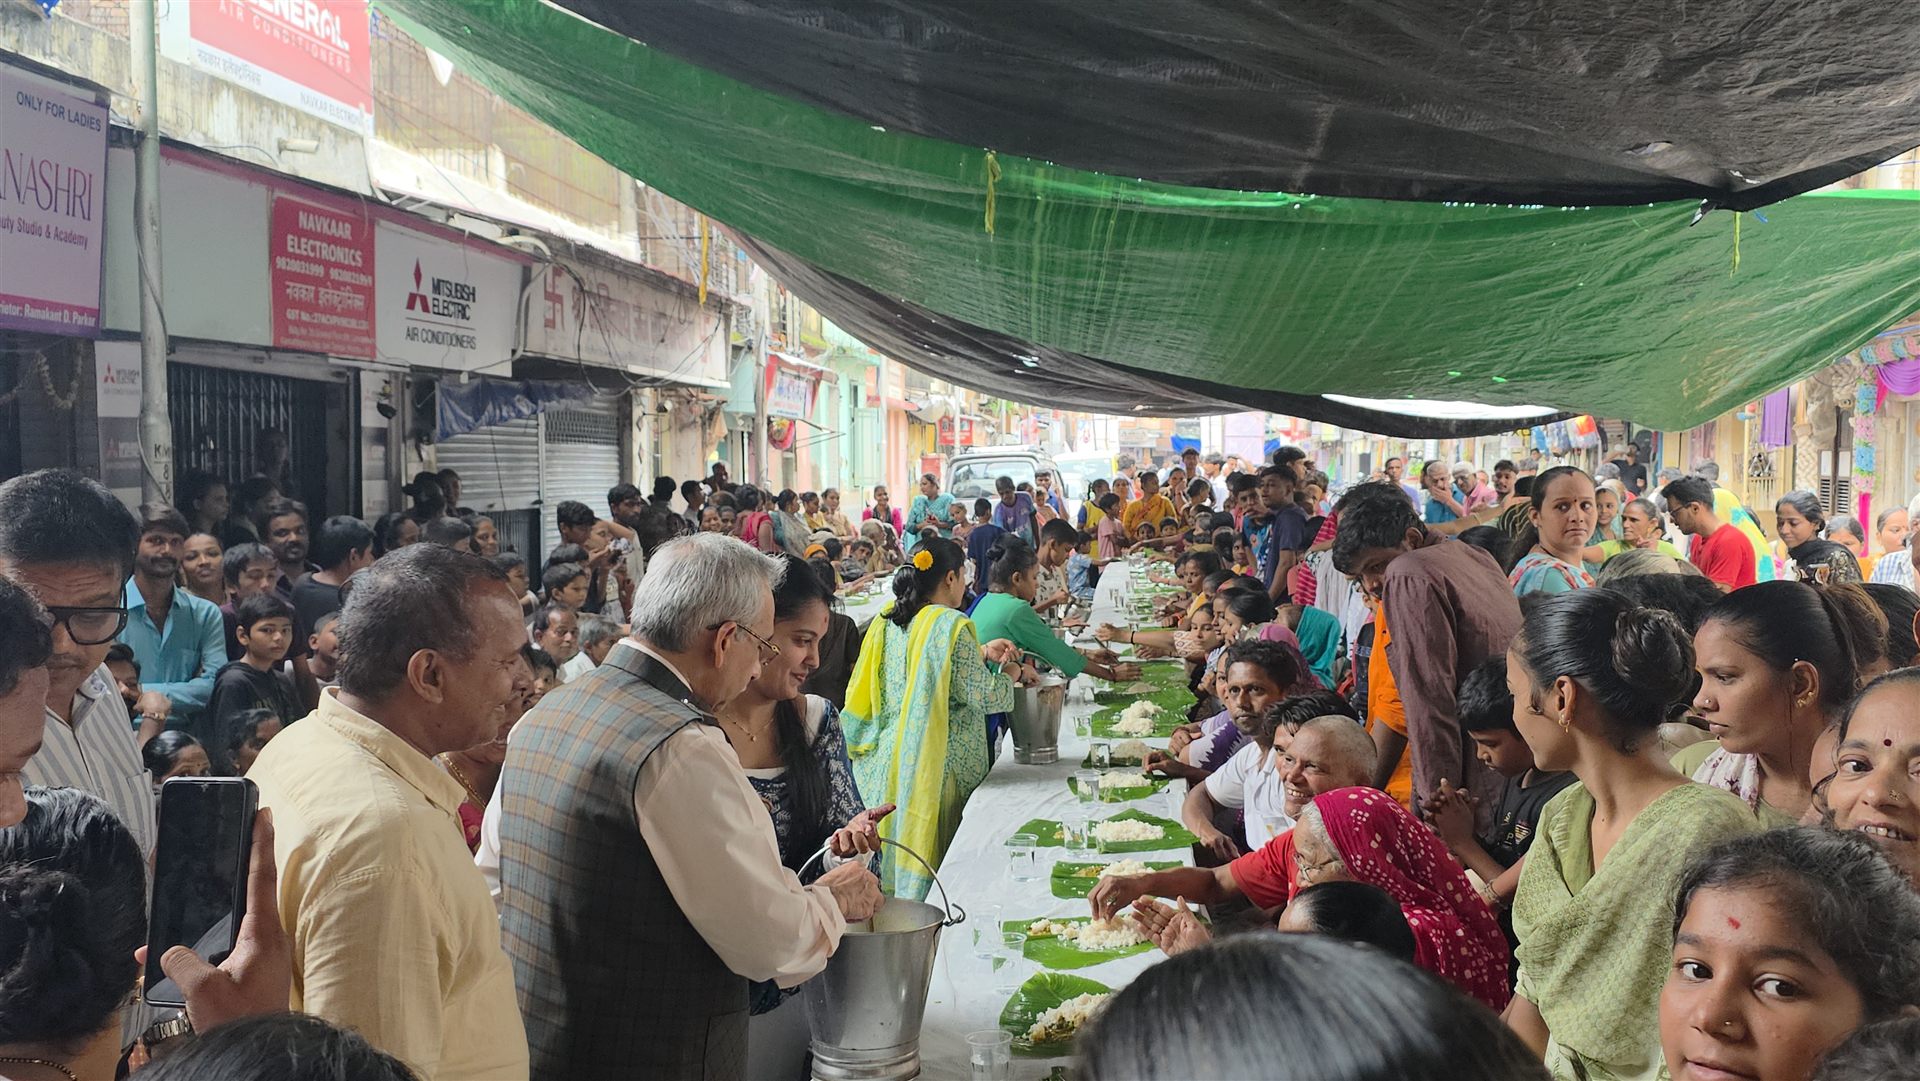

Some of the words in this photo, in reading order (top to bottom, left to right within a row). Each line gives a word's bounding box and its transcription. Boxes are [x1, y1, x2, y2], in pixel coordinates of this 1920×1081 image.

[218, 0, 245, 22] AIR
[253, 15, 351, 73] CONDITIONERS
[245, 0, 350, 51] NERAL
[16, 91, 43, 112] ONLY
[45, 101, 65, 120] FOR
[67, 109, 101, 132] LADIES
[0, 148, 92, 221] NASHRI
[0, 214, 15, 234] uty
[17, 217, 43, 238] Studio
[45, 223, 51, 239] &
[53, 225, 88, 250] Academy
[298, 210, 352, 240] NAVKAAR
[286, 233, 363, 267] ELECTRONICS
[431, 276, 476, 303] MITSUBISHI
[24, 303, 62, 323] Ramakant
[72, 311, 97, 327] Parkar
[431, 297, 471, 321] ELECTRIC
[405, 326, 419, 342] AIR
[420, 328, 476, 350] CONDITIONERS
